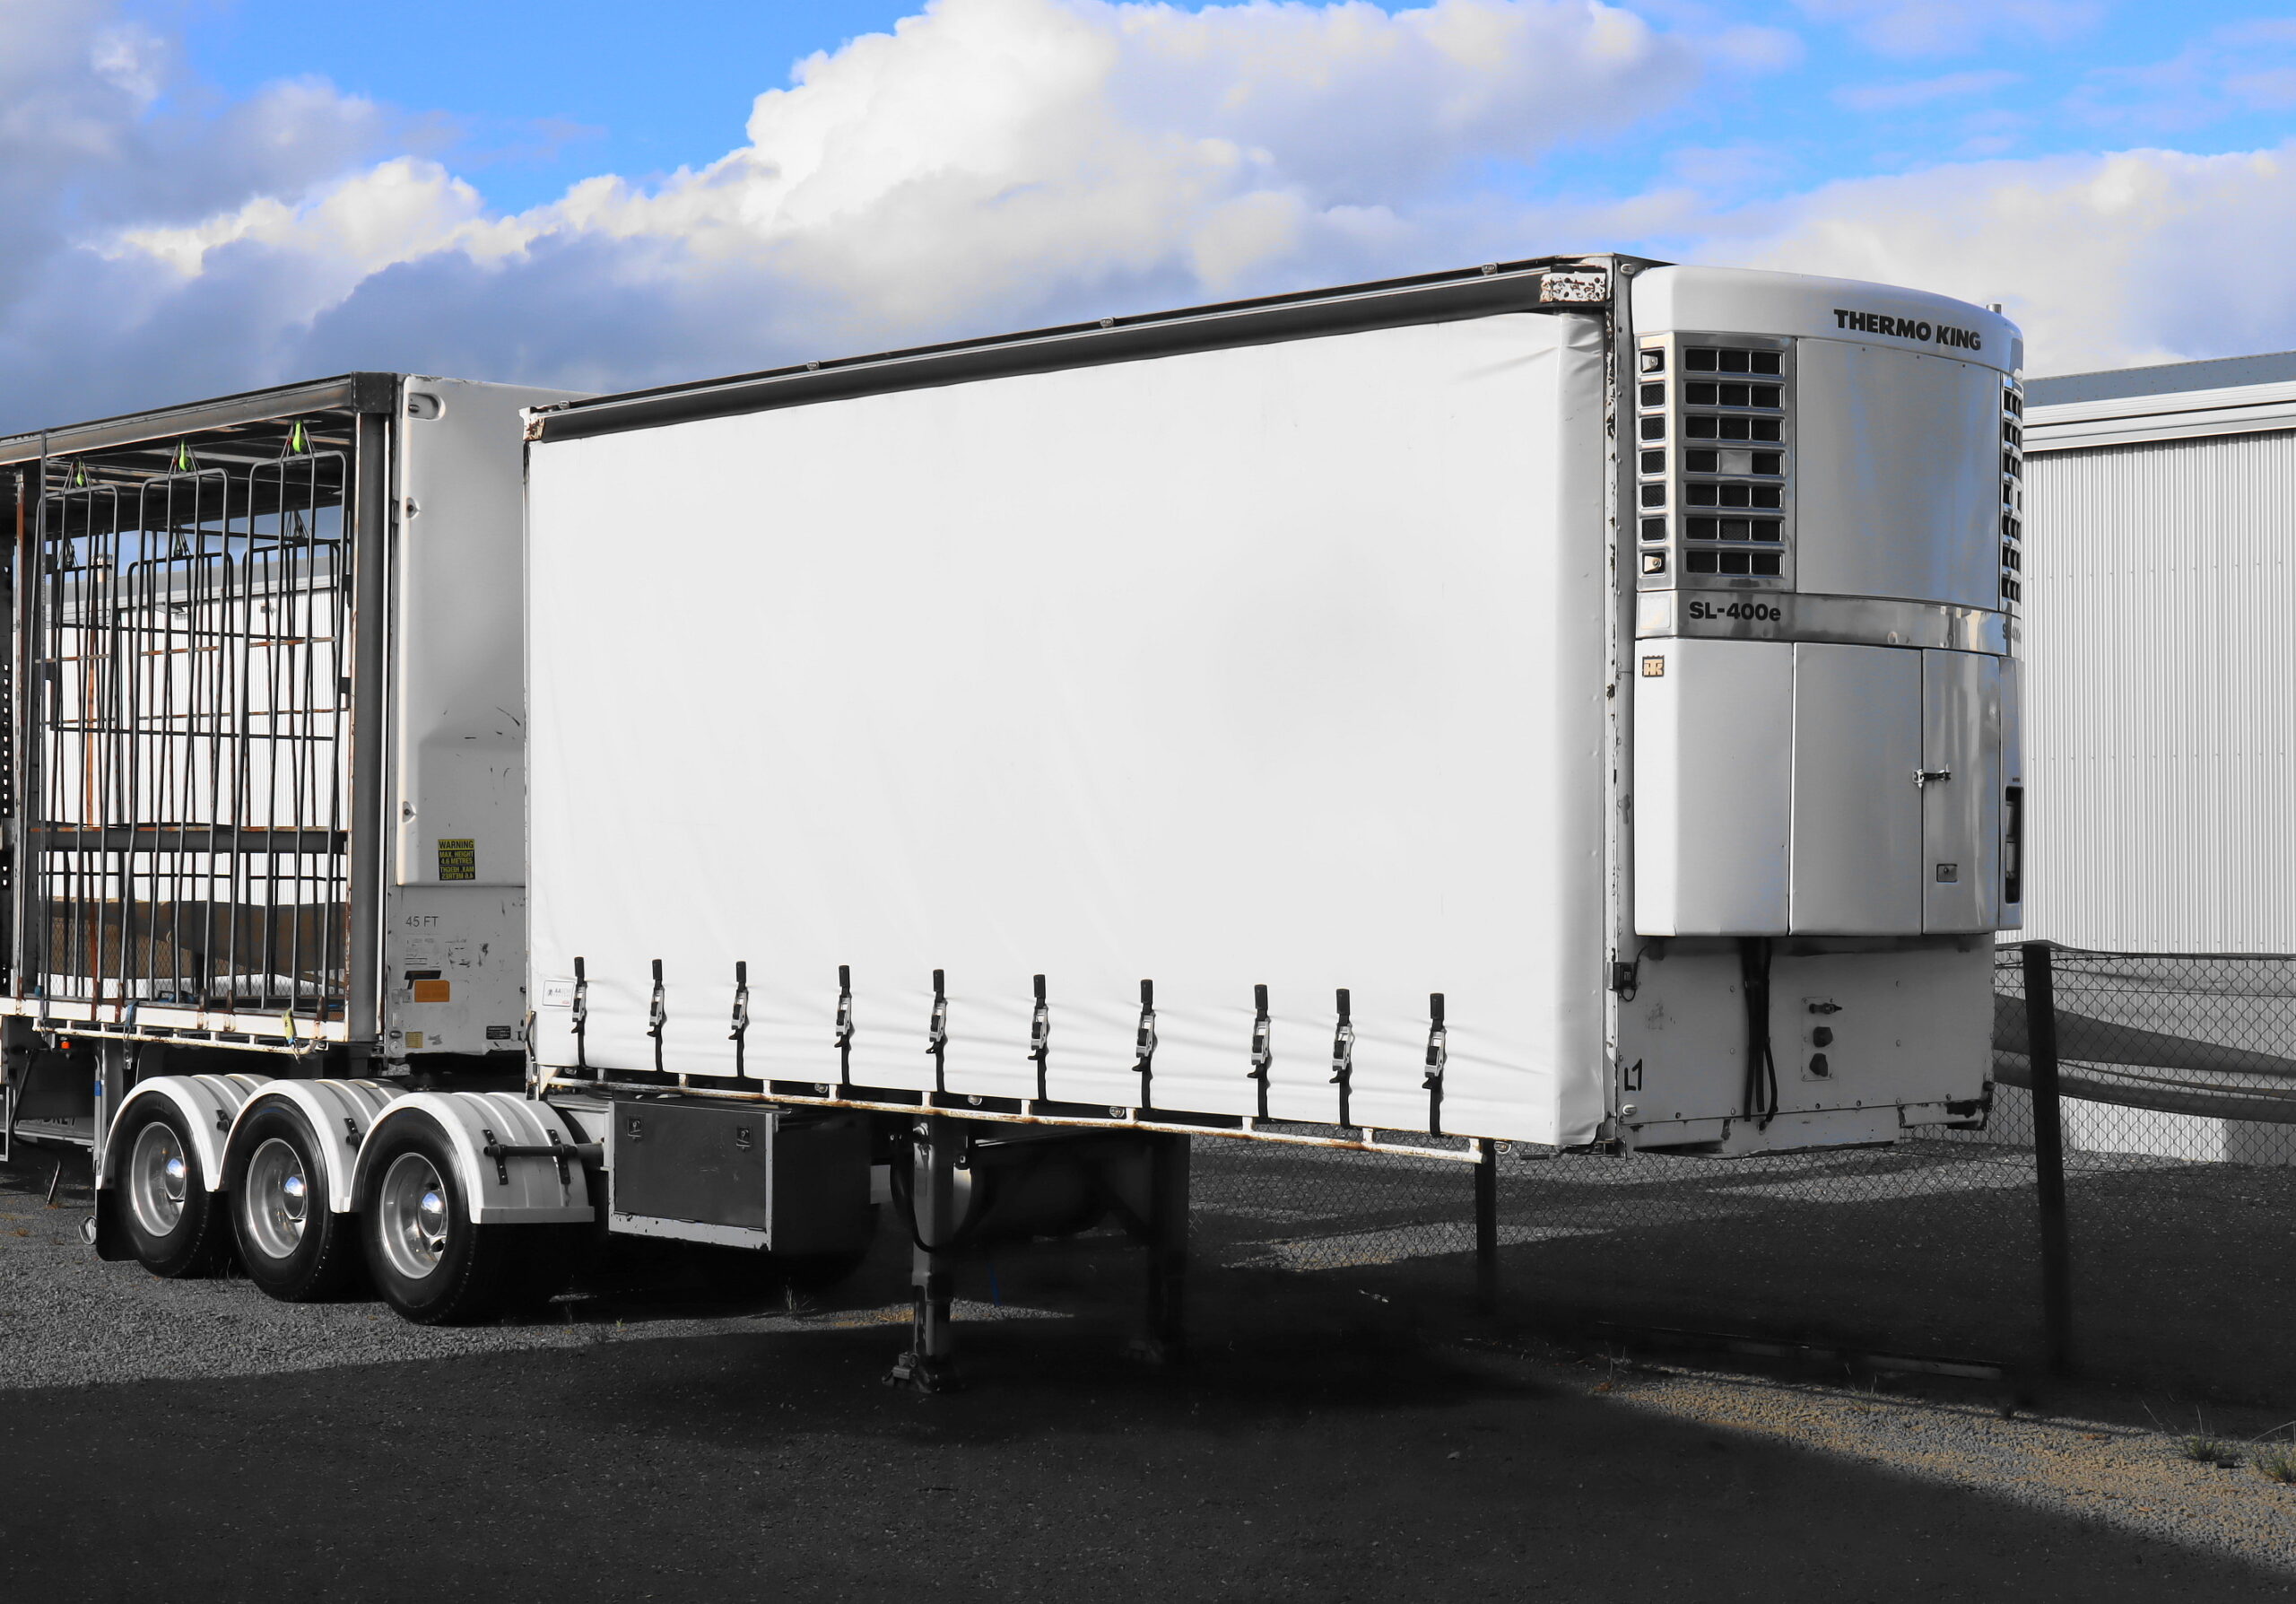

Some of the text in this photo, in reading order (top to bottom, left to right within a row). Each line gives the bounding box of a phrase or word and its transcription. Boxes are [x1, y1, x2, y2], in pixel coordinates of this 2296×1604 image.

[1833, 309, 1982, 351] THERMO KING
[1689, 601, 1781, 622] SL-400e
[439, 840, 474, 849] WARNING
[405, 916, 439, 928] 45 FT
